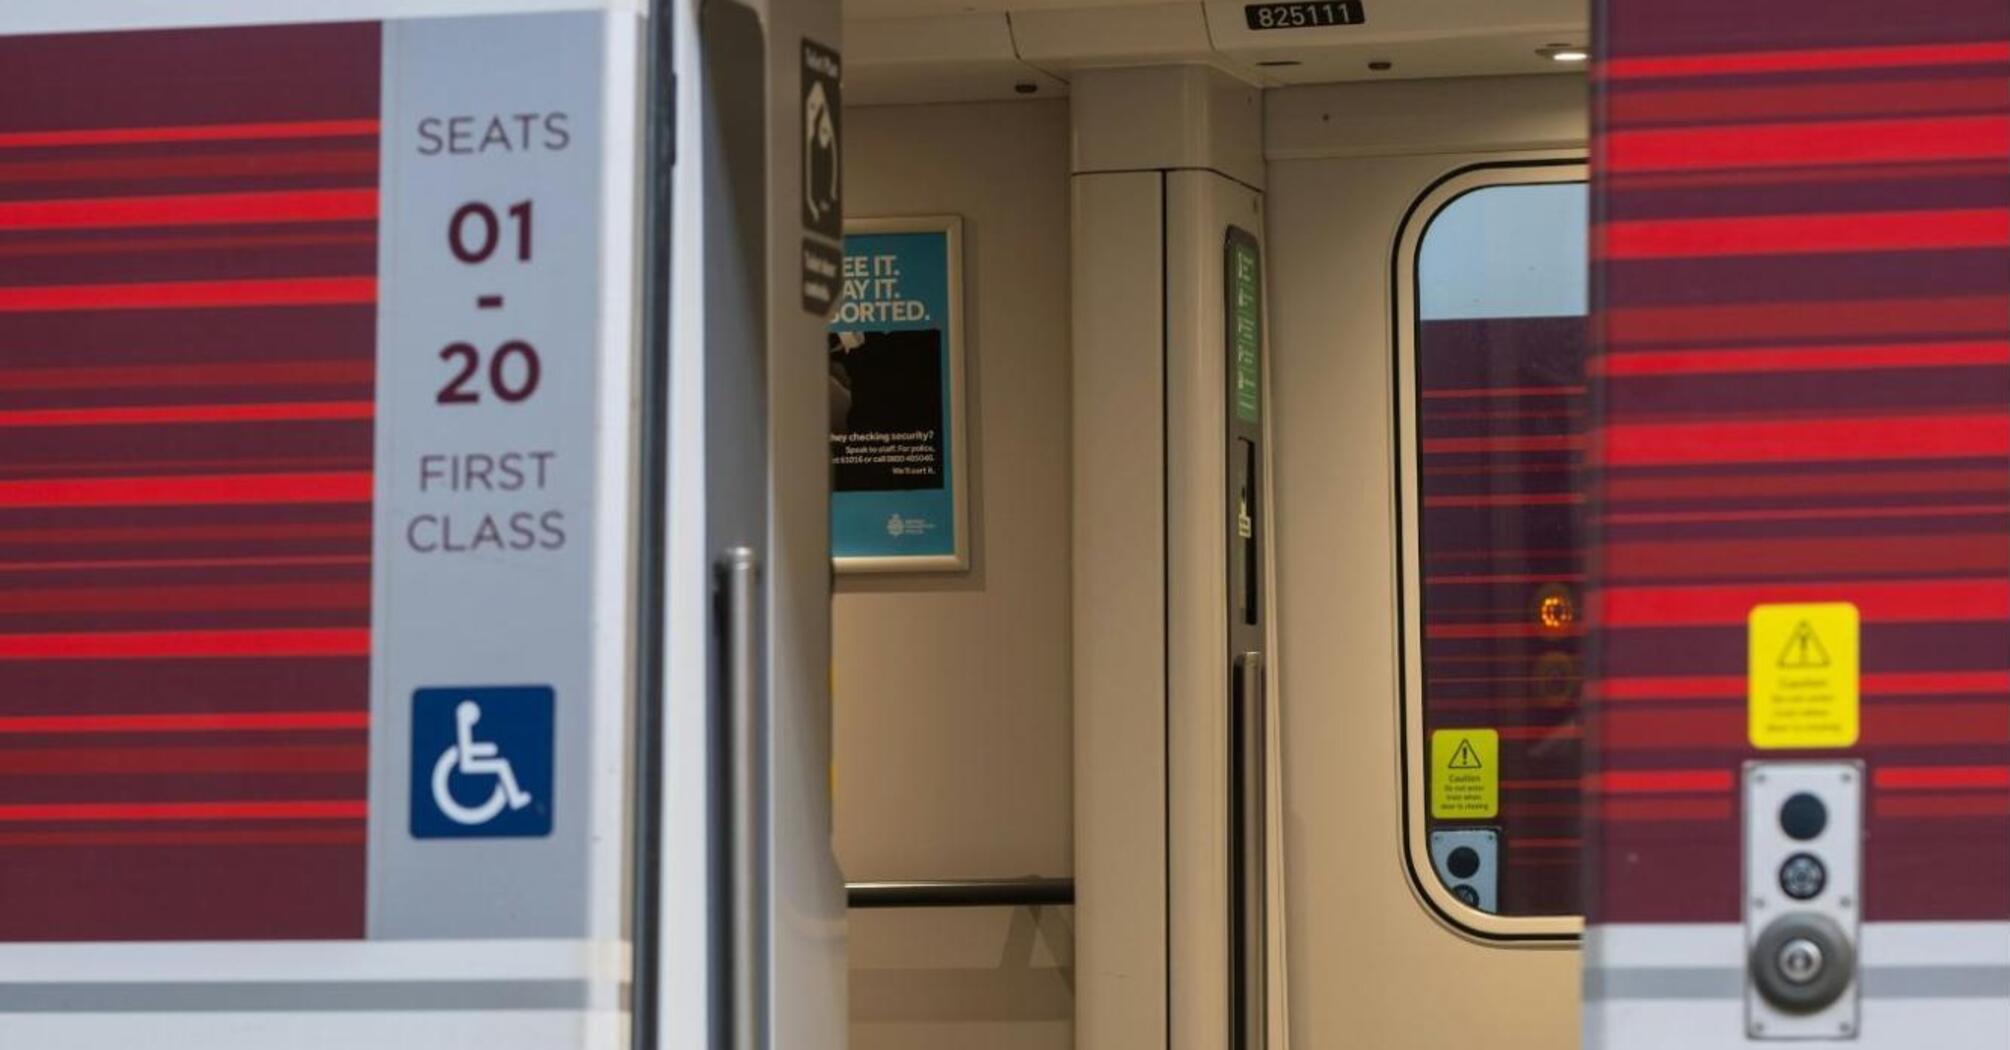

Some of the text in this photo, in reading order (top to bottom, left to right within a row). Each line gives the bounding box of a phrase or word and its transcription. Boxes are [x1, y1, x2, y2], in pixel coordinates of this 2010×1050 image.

[1258, 3, 1349, 27] 825111
[417, 112, 570, 156] SEATS
[448, 200, 533, 264] 01
[842, 255, 869, 277] EE
[874, 255, 900, 276] IT.
[842, 278, 900, 300] AY IT.
[436, 340, 540, 404] 20
[849, 431, 890, 443] checking
[891, 430, 935, 442] security?
[420, 451, 555, 492] FIRST
[407, 511, 565, 553] CLASS
[1448, 774, 1481, 783] Caution
